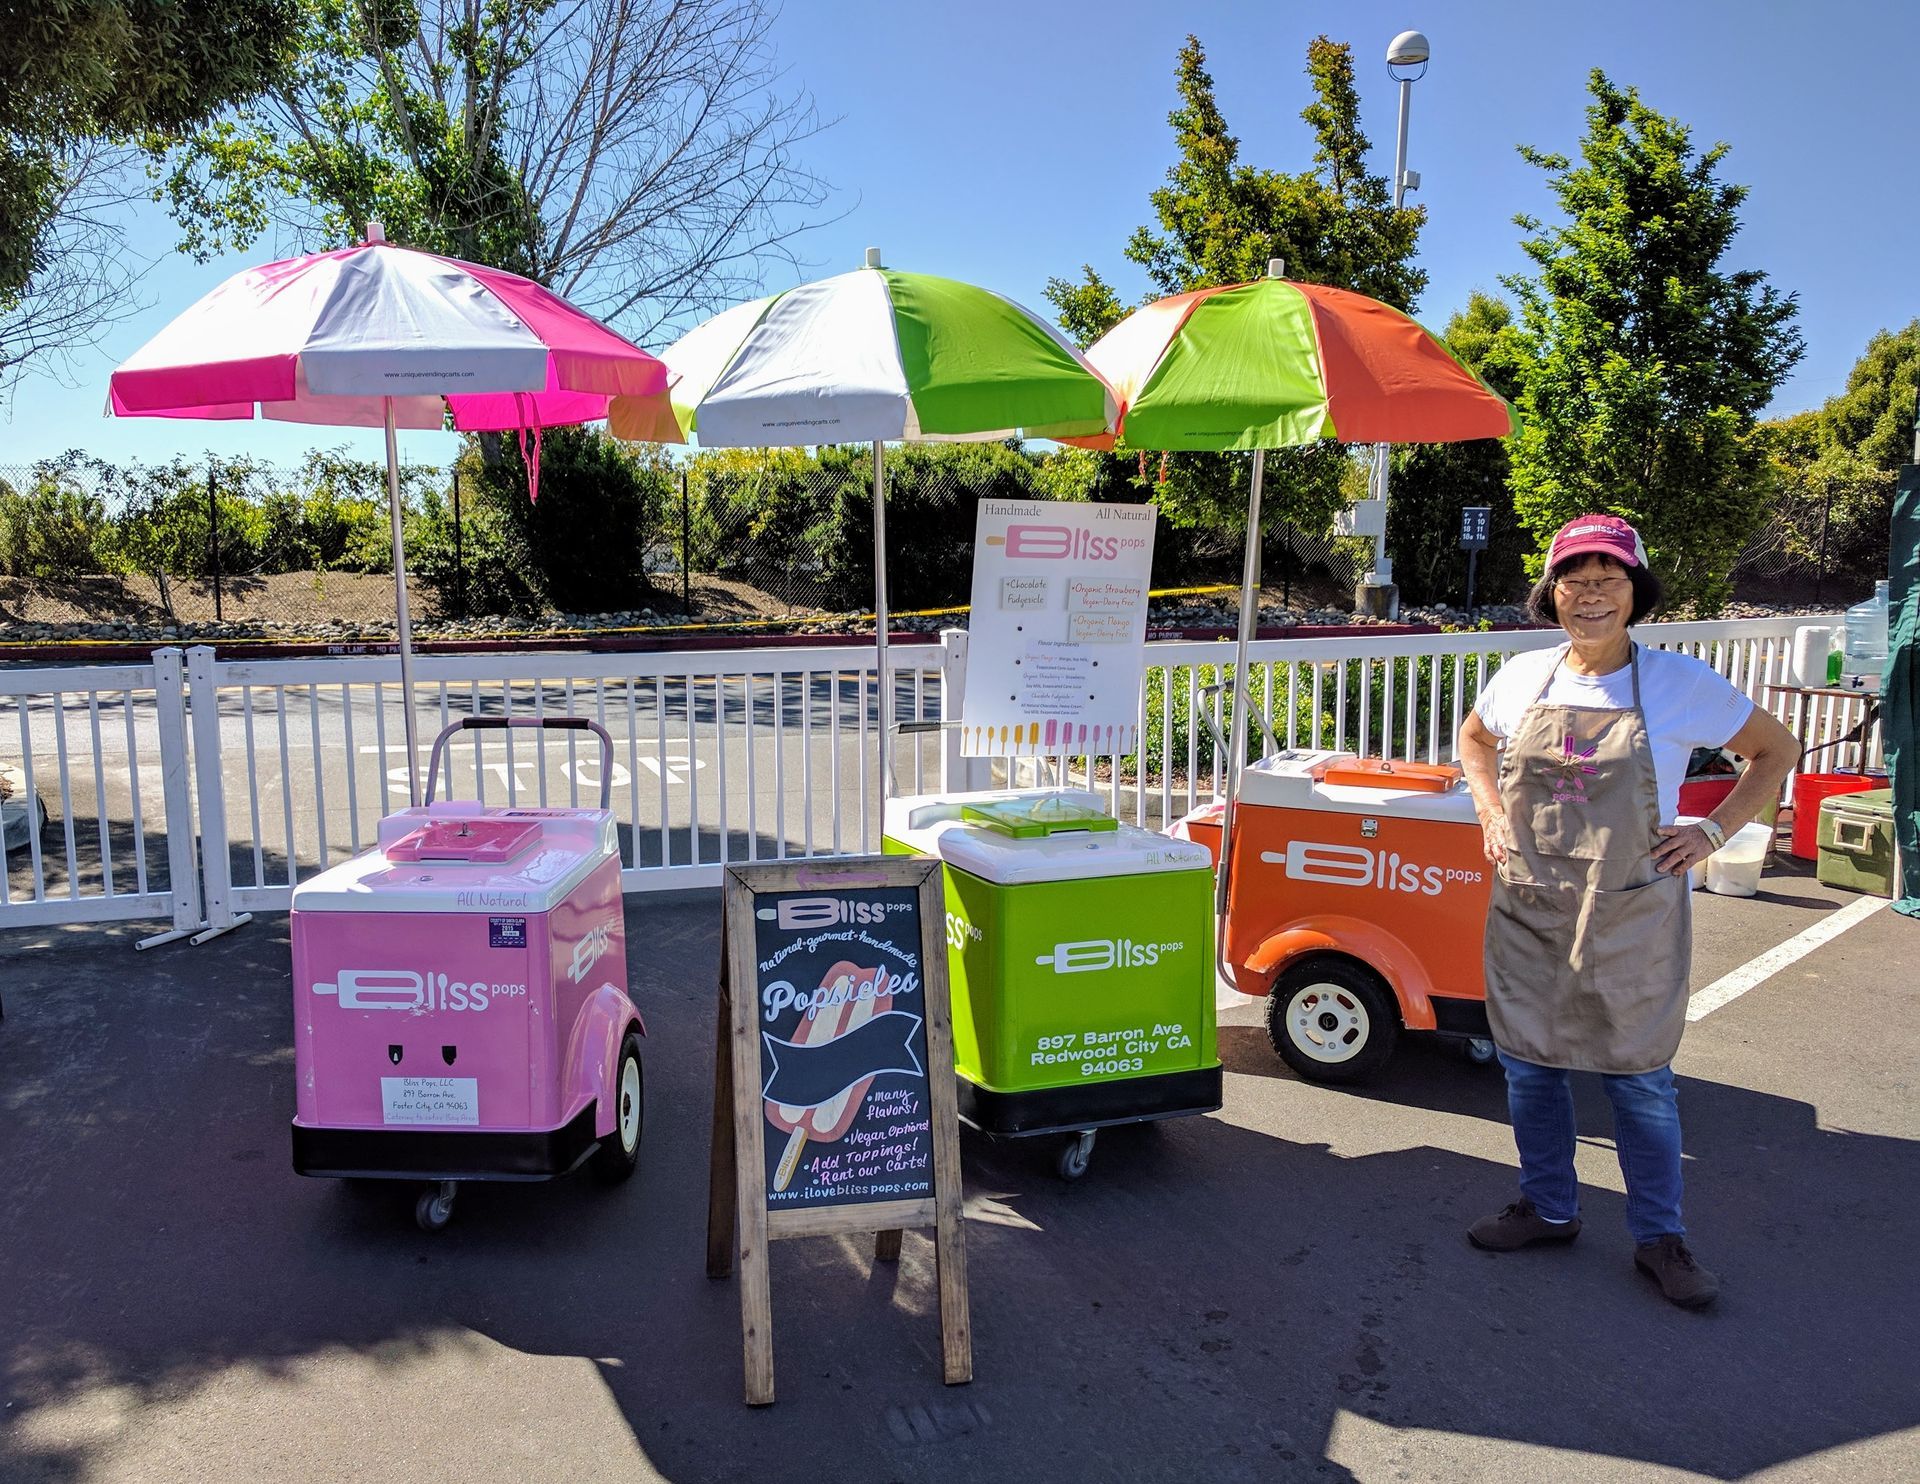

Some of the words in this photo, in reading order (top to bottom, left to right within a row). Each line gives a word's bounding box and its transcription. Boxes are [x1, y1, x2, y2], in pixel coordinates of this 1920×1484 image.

[985, 504, 1042, 517] Handmade
[1096, 508, 1111, 520] All
[1113, 509, 1151, 521] Natural
[1005, 525, 1119, 561] Bliss
[1120, 538, 1145, 549] pops
[1075, 583, 1103, 597] Organic
[347, 646, 367, 655] LANE
[1285, 840, 1443, 896] Bliss
[1446, 868, 1482, 884] pops
[457, 892, 476, 906] All
[479, 892, 529, 907] Natural
[777, 897, 886, 930] Bliss
[886, 903, 913, 913] pops
[965, 923, 983, 942] pops
[1054, 938, 1159, 974] Bliss
[1160, 941, 1184, 953] pops
[337, 969, 489, 1012] Bliss
[492, 983, 526, 998] pops
[1037, 1034, 1076, 1050] 897
[1083, 1028, 1144, 1046] Barron
[1151, 1023, 1183, 1037] Ave
[1030, 1045, 1117, 1066] Redwood
[1125, 1040, 1159, 1057] City
[1166, 1035, 1191, 1049] CA
[1081, 1058, 1143, 1076] 94063
[392, 1101, 413, 1110] Foster
[433, 1102, 444, 1110] CA
[850, 1129, 887, 1146] Vegan
[811, 1155, 839, 1173] Add
[846, 1137, 919, 1164] Toppings!
[820, 1169, 854, 1186] Rent
[858, 1165, 882, 1177] our
[886, 1153, 927, 1172] Carts!
